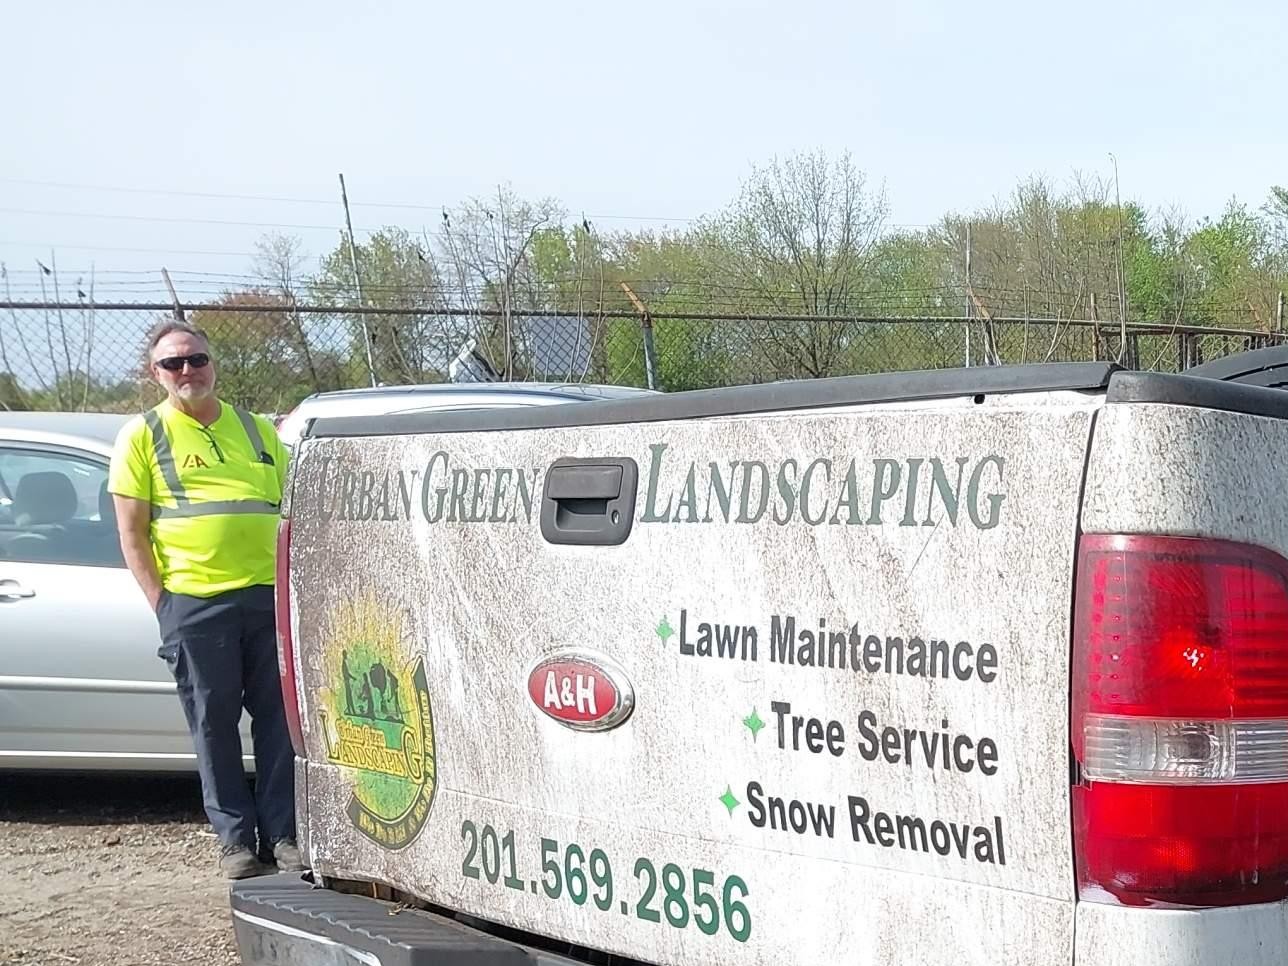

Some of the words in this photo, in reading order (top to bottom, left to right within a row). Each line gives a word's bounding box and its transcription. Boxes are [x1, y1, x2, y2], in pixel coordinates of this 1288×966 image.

[421, 450, 540, 524] GREEN
[639, 443, 1006, 529] LANDSCAPING
[679, 609, 759, 661] Lawn
[770, 615, 999, 683] Maintenance
[542, 670, 597, 716] A&H
[771, 700, 844, 756] Tree
[858, 710, 999, 776] Service
[747, 781, 836, 838] Snow
[849, 795, 1007, 865] Removal
[460, 820, 752, 943] 201.569.2856
